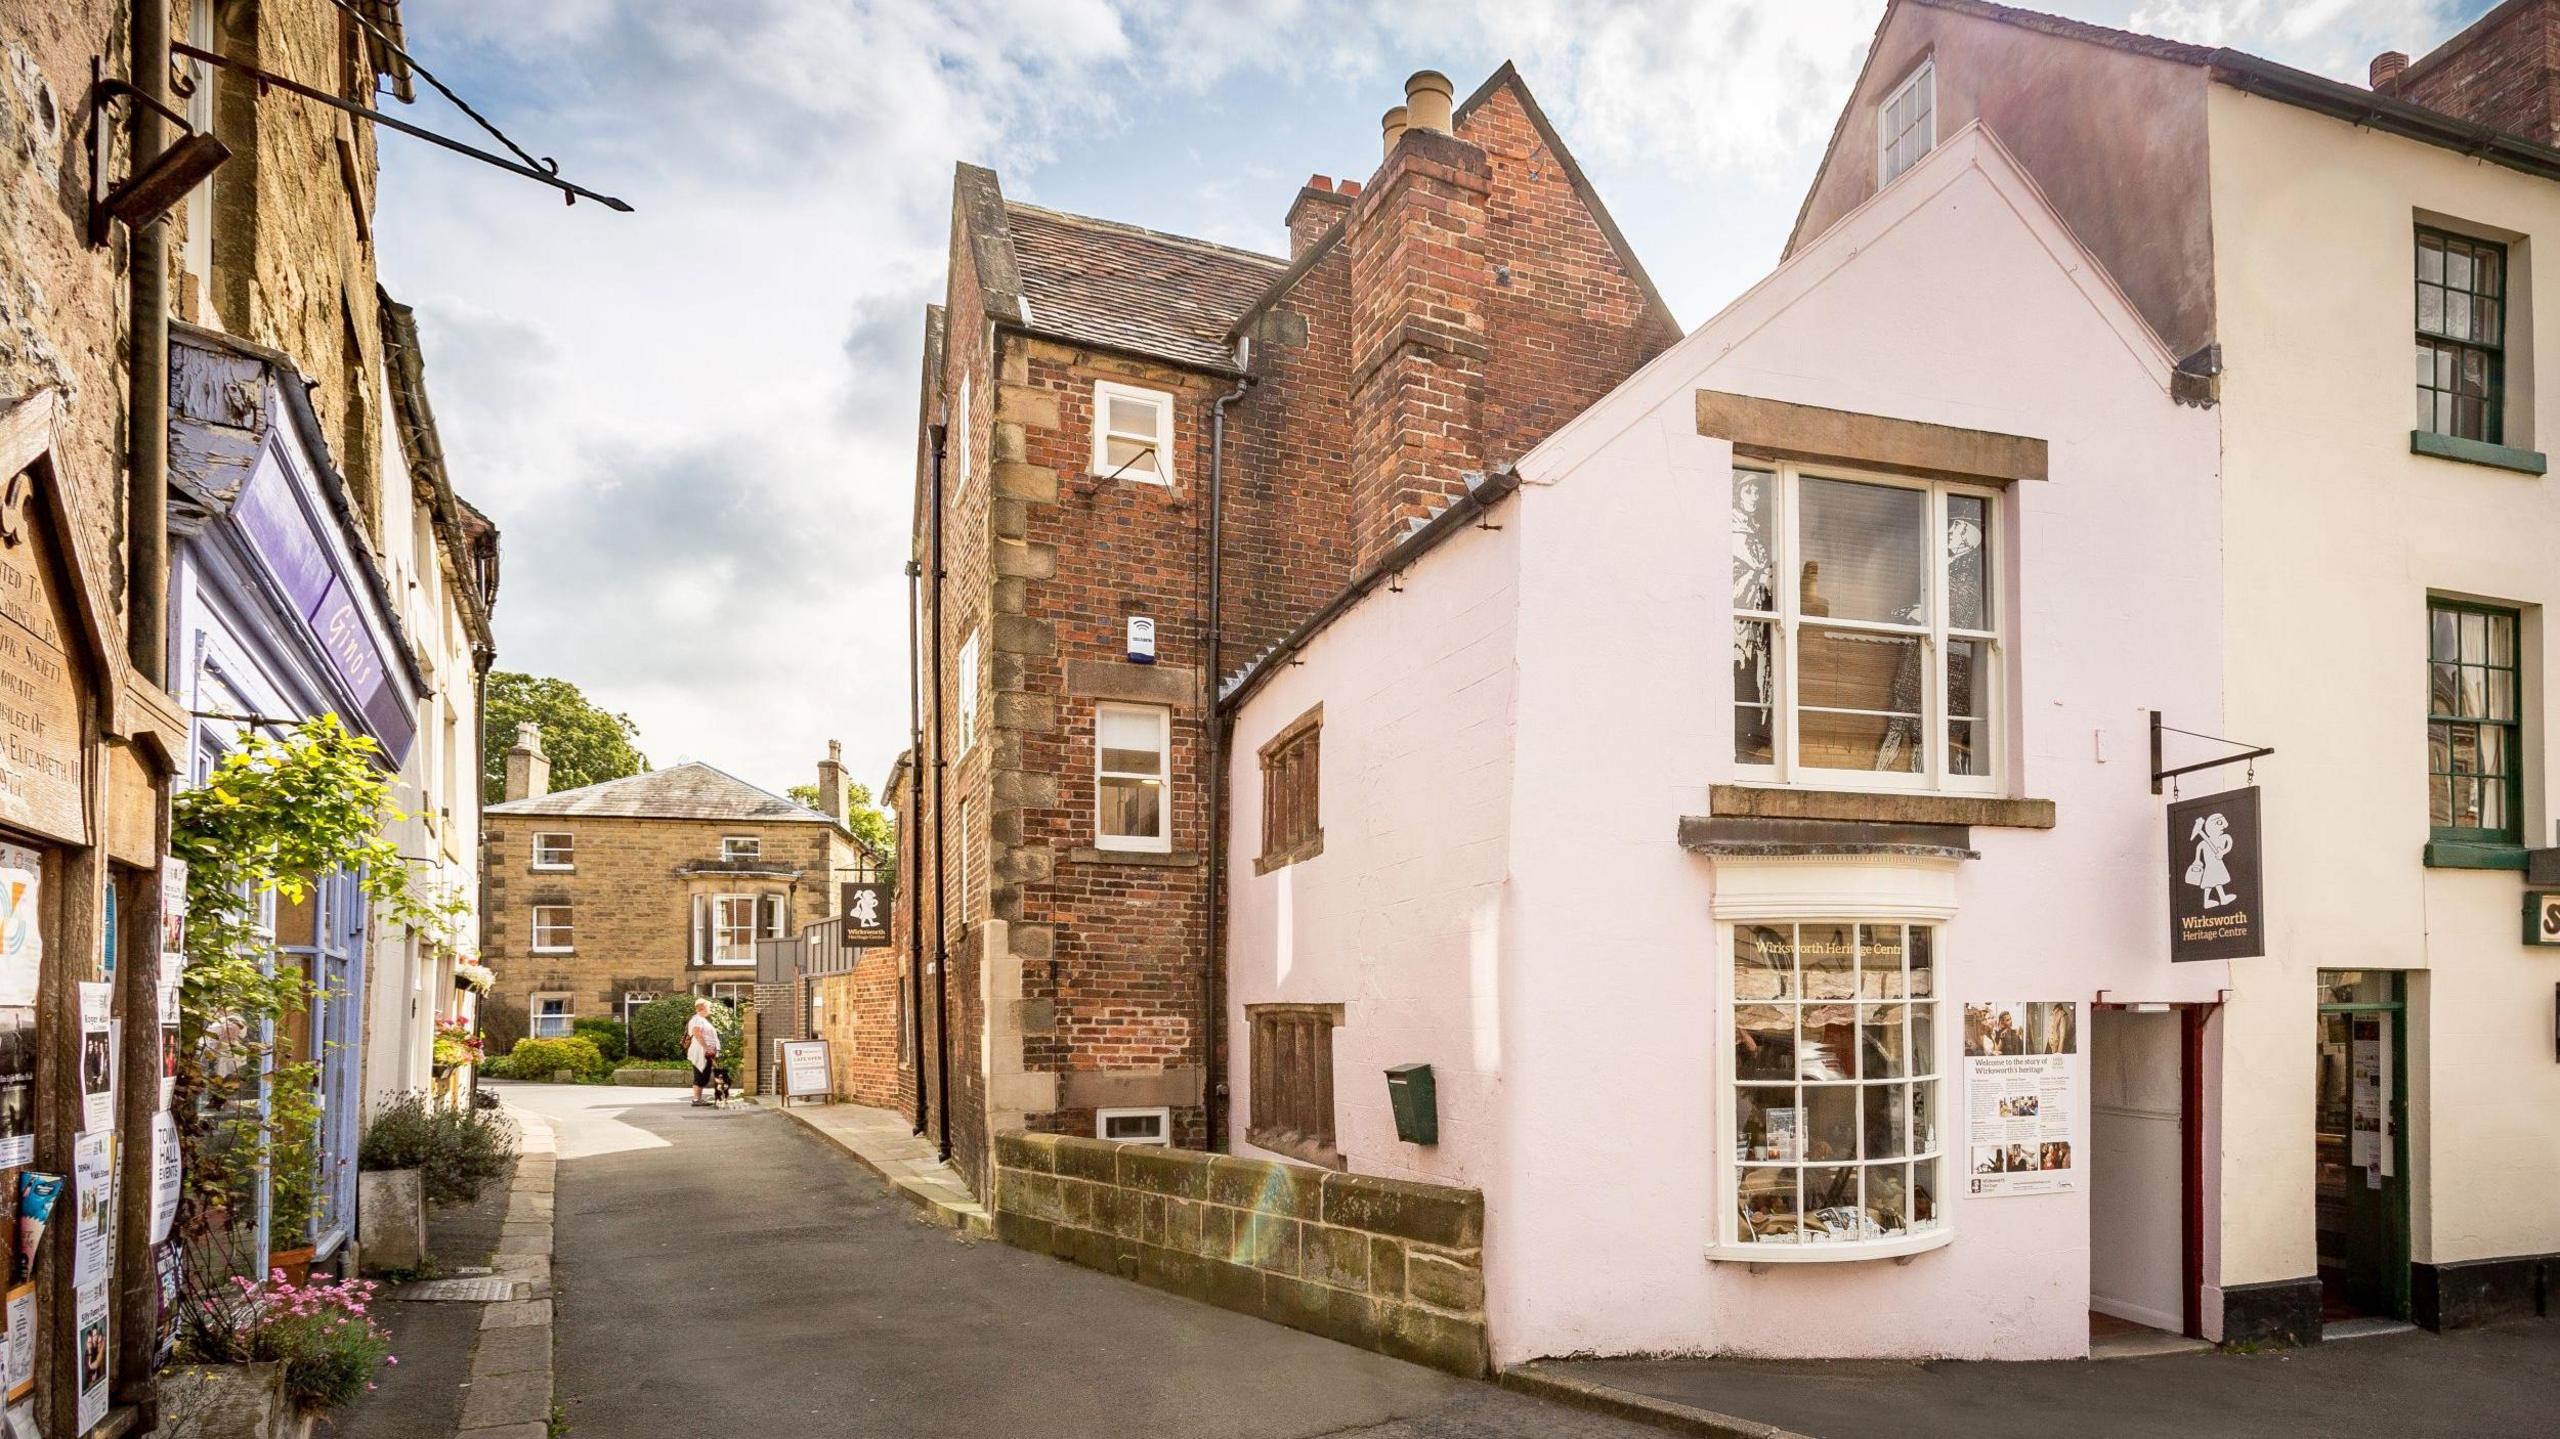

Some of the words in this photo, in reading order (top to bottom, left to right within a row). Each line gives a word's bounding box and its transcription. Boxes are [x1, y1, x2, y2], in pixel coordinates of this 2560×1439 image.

[329, 604, 375, 685] Gino's
[10, 733, 67, 781] ELIZABETH
[2182, 911, 2248, 929] Wirksworth
[2183, 930, 2217, 941] Heritage
[2218, 927, 2248, 938] Centre
[1825, 942, 1871, 957] Heritge
[1873, 943, 1901, 955] Centr
[2019, 1066, 2044, 1074] heritage
[2024, 1058, 2040, 1067] story
[2041, 1057, 2047, 1065] of
[158, 1127, 176, 1144] TOWN
[160, 1144, 178, 1164] HALL
[159, 1165, 178, 1180] EVENTS
